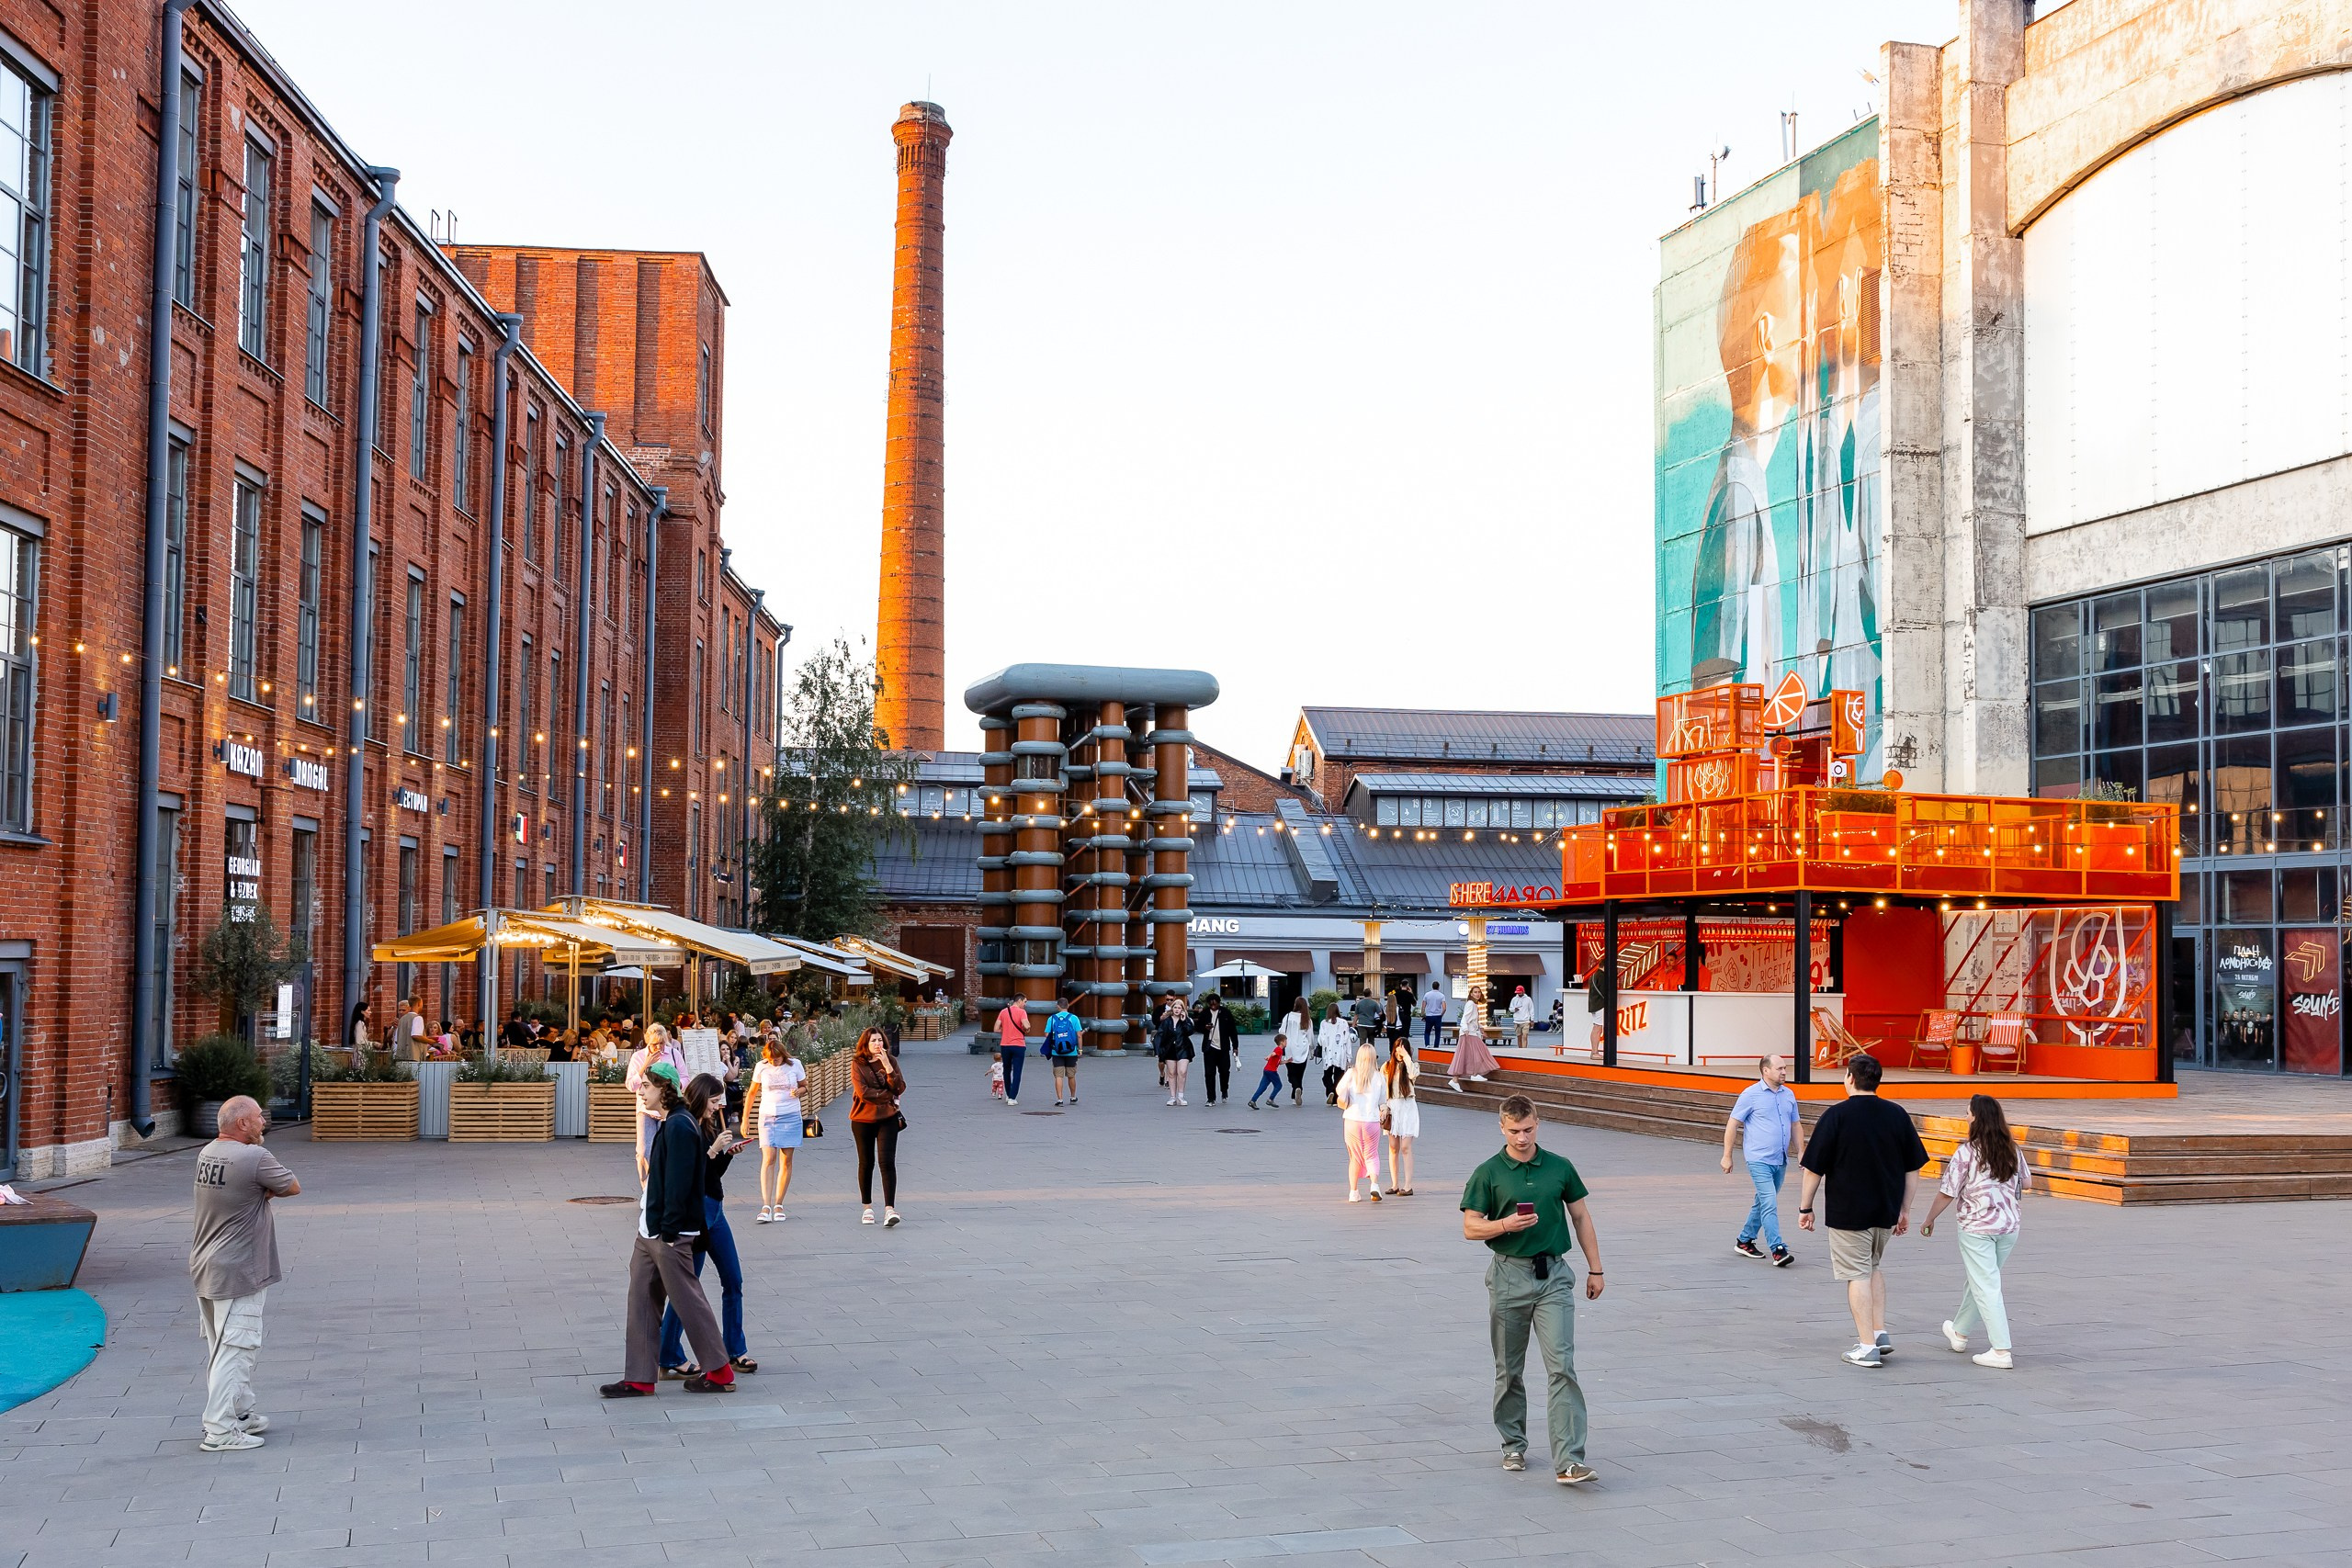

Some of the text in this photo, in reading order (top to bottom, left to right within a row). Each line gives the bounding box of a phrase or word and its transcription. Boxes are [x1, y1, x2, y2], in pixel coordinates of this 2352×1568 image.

[230, 742, 263, 777] KAZAN
[402, 790, 428, 812] ЕСТОРАН
[228, 856, 261, 876] GEORGIAN
[1450, 882, 1492, 904] IS HERE
[1497, 925, 1530, 935] HUMMUS
[1810, 943, 1829, 959] TAGIO
[1760, 960, 1792, 981] RICETTA
[196, 1161, 225, 1185] IESEL
